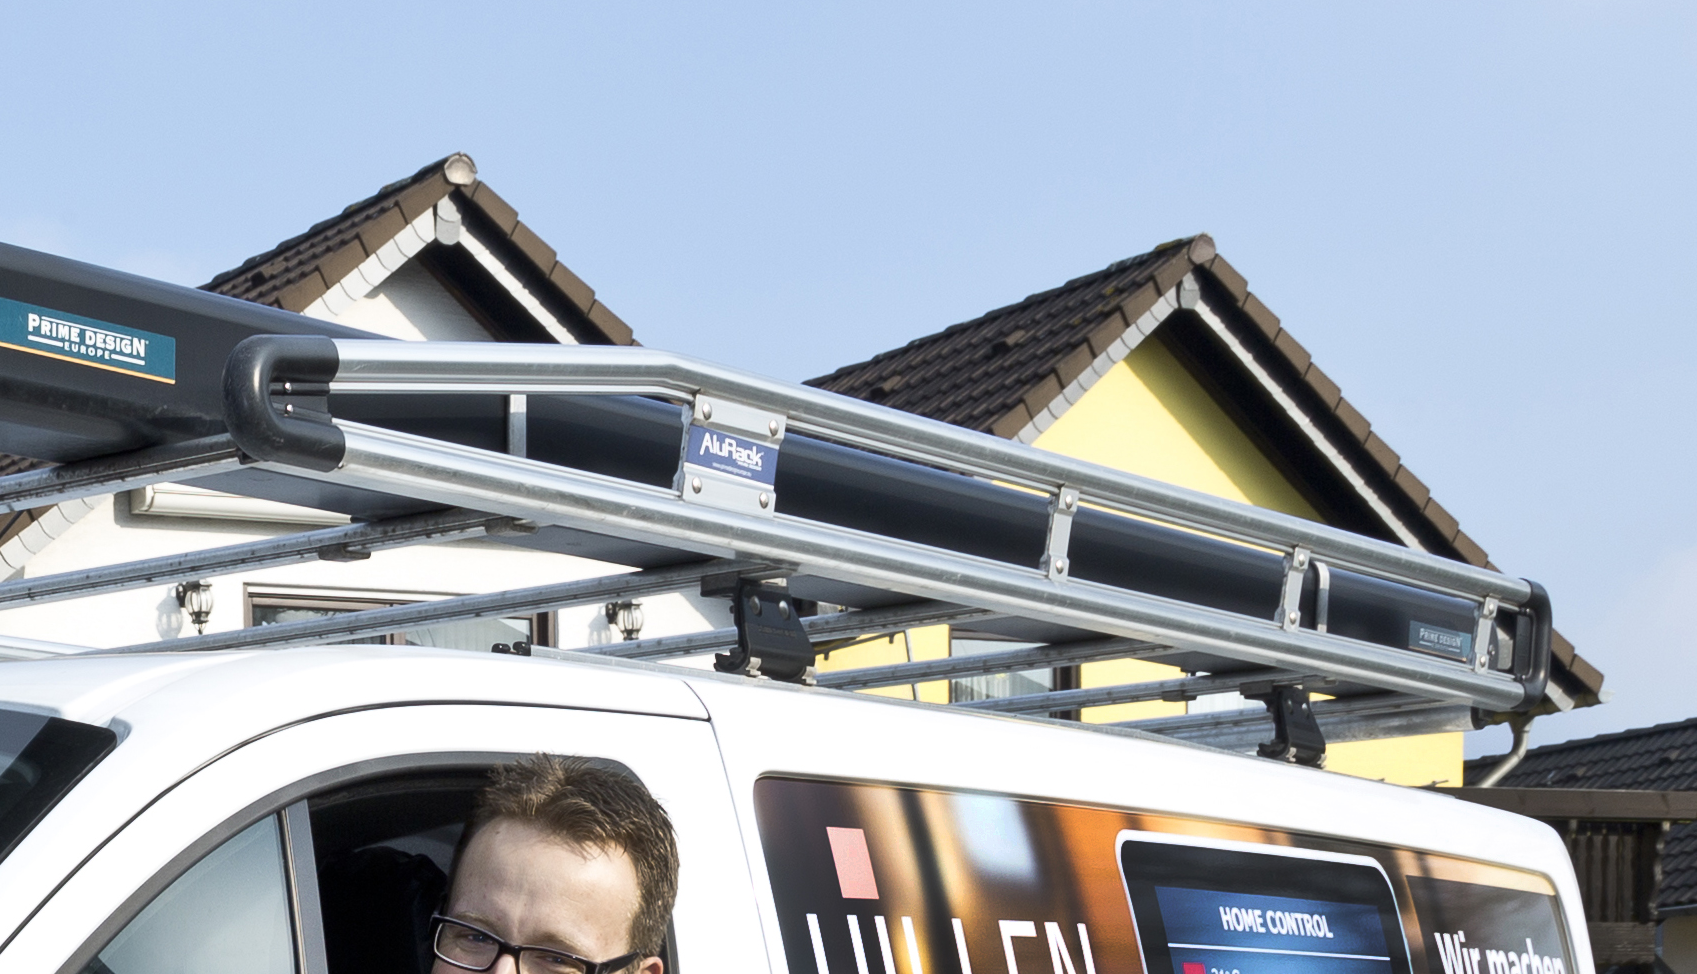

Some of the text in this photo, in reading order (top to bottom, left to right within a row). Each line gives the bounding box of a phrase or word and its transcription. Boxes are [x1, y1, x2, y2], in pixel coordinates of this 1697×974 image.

[27, 312, 80, 342] PRIME
[63, 342, 111, 360] EUROPE
[699, 431, 765, 467] AluRack
[1219, 905, 1334, 939] HOME CONTROL
